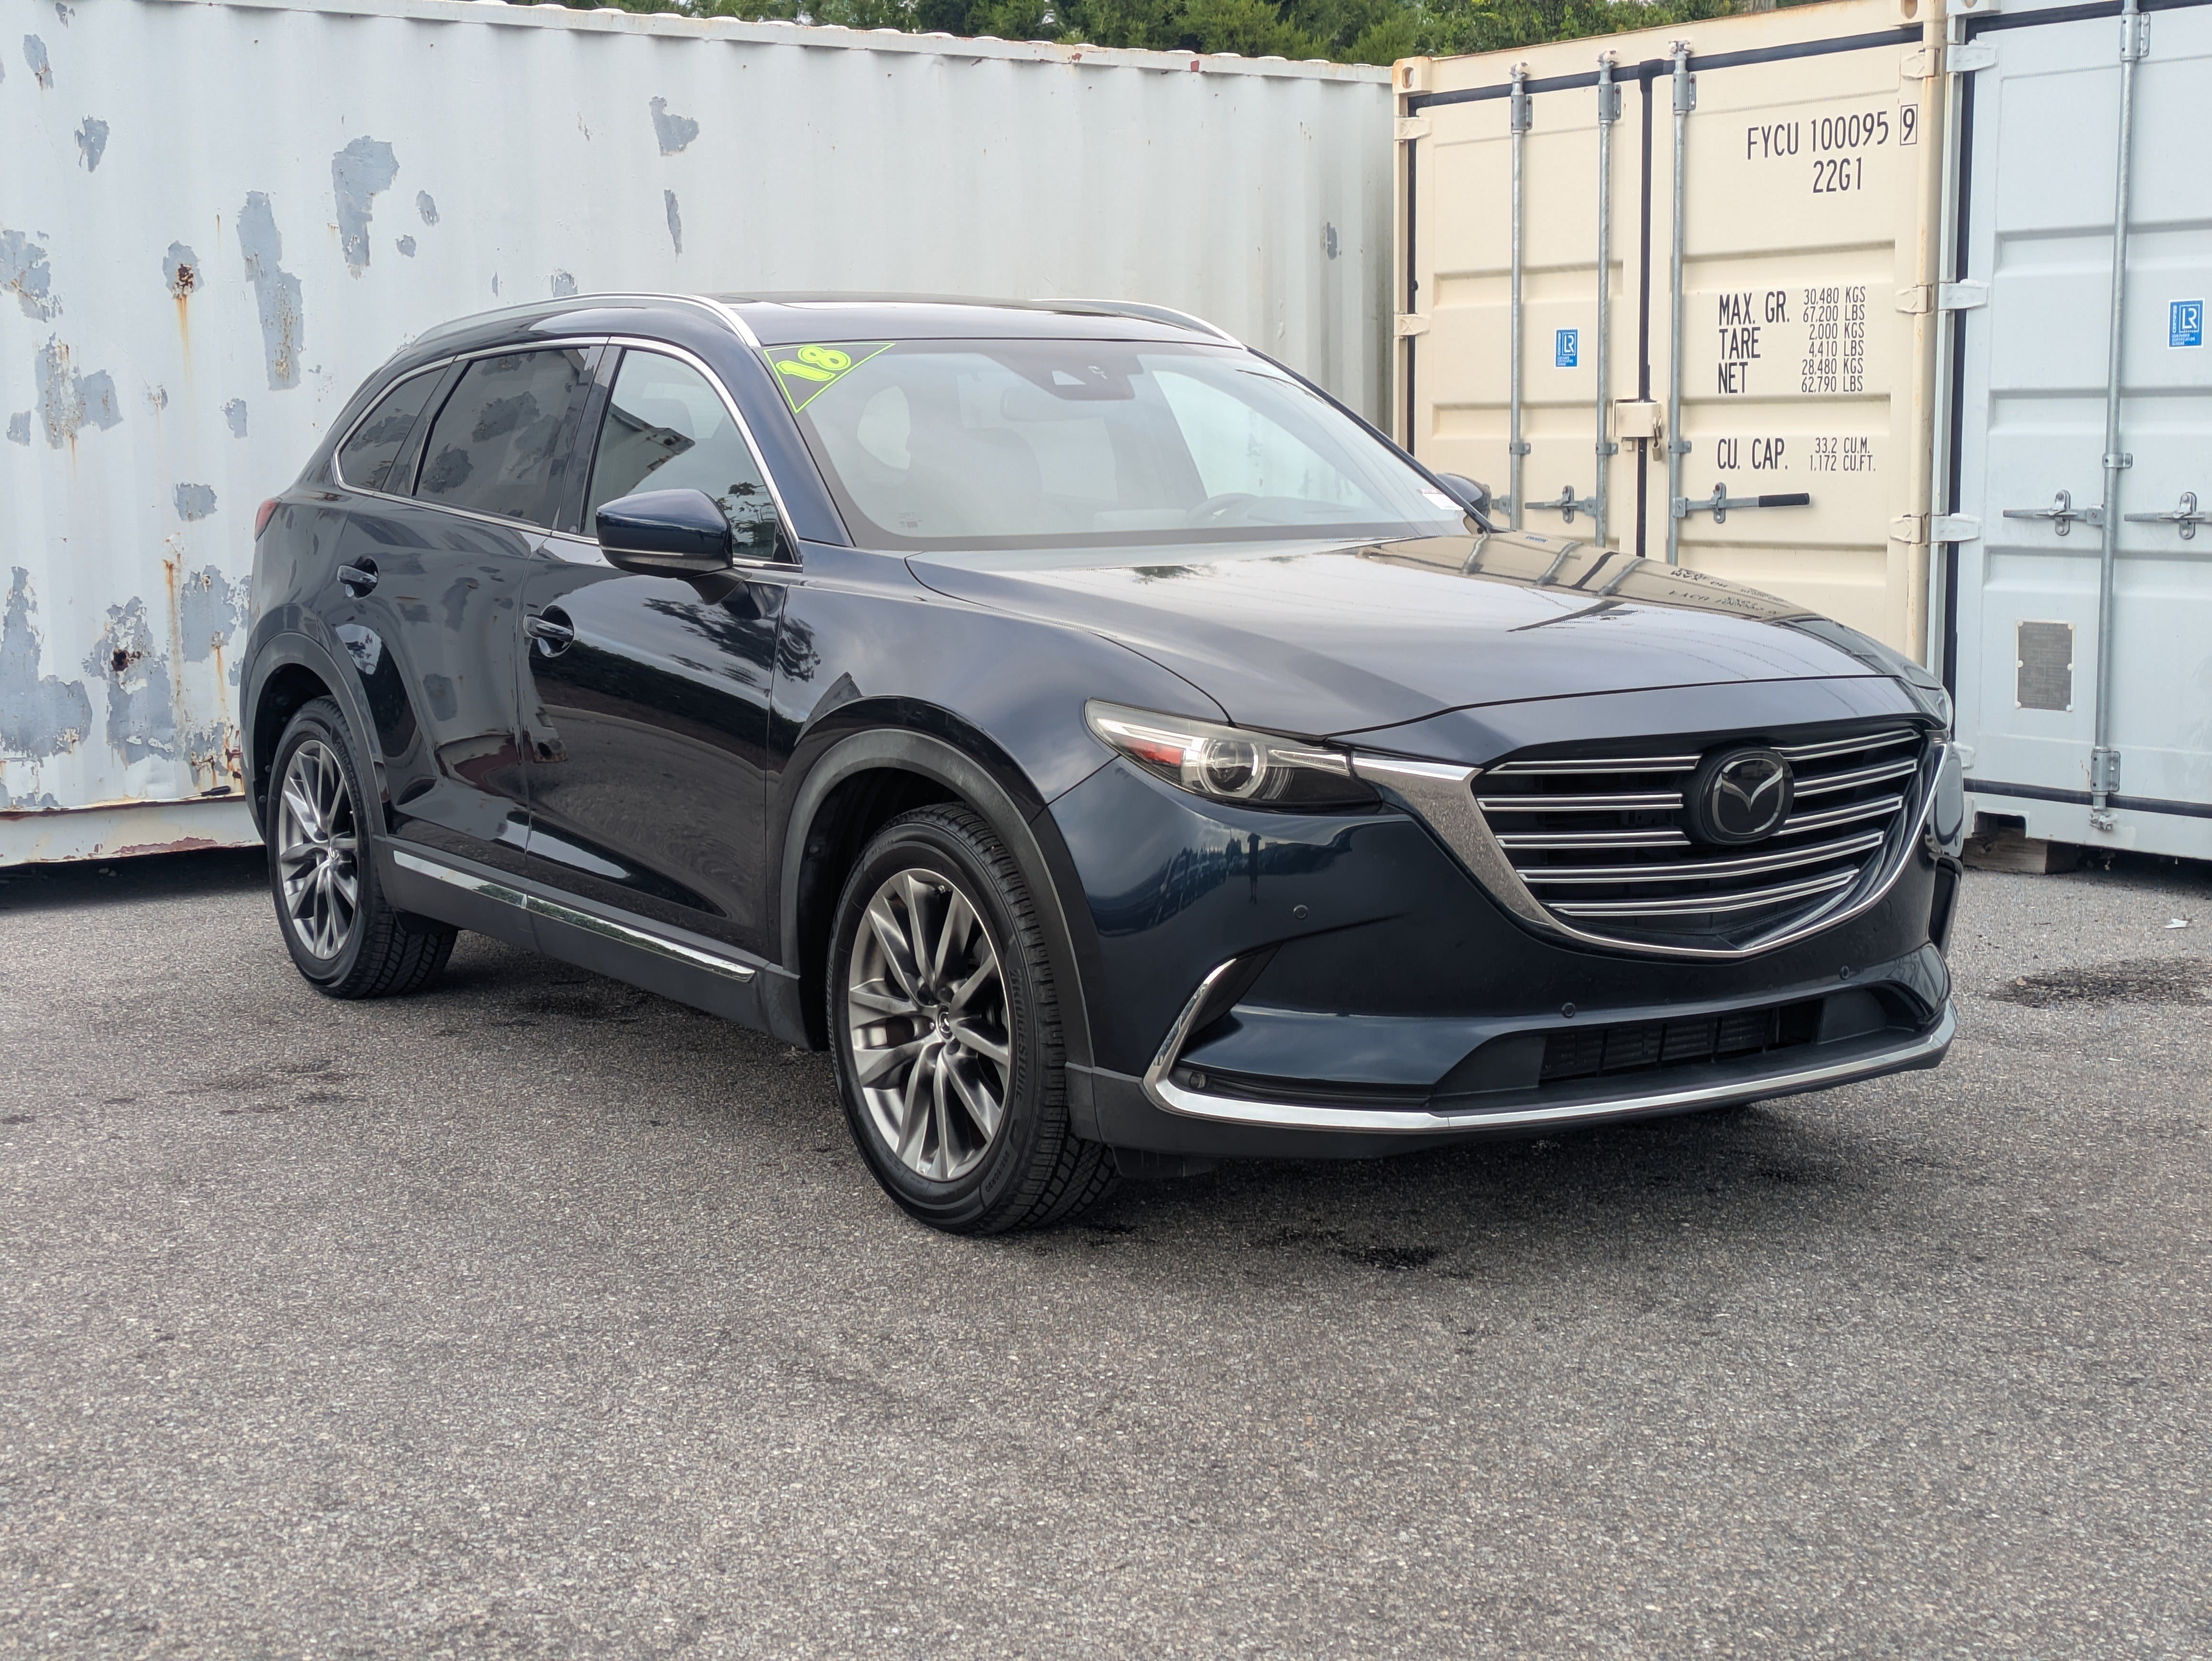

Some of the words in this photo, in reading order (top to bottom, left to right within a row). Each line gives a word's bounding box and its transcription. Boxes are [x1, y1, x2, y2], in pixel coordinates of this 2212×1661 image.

[1747, 122, 1799, 160] FYCU
[1811, 111, 1889, 152] 100095
[1903, 108, 1915, 142] 9
[1813, 156, 1862, 193] 22G1
[1719, 292, 1756, 326] MAX.
[1765, 290, 1790, 323] GR.
[1803, 287, 1839, 306] 30,480
[1845, 286, 1866, 303] KGS
[1845, 304, 1865, 321] LBS
[1719, 326, 1761, 360] TARE
[1844, 322, 1865, 339] KGS
[776, 346, 852, 382] 18
[1844, 340, 1864, 356] LBS
[1718, 361, 1748, 394] NET
[1843, 357, 1863, 375] KGS
[1843, 375, 1863, 392] LBS
[1717, 438, 1740, 470] CU.
[1752, 438, 1788, 470] CAP.
[1009, 968, 1028, 1101] BRIDGESTONE
